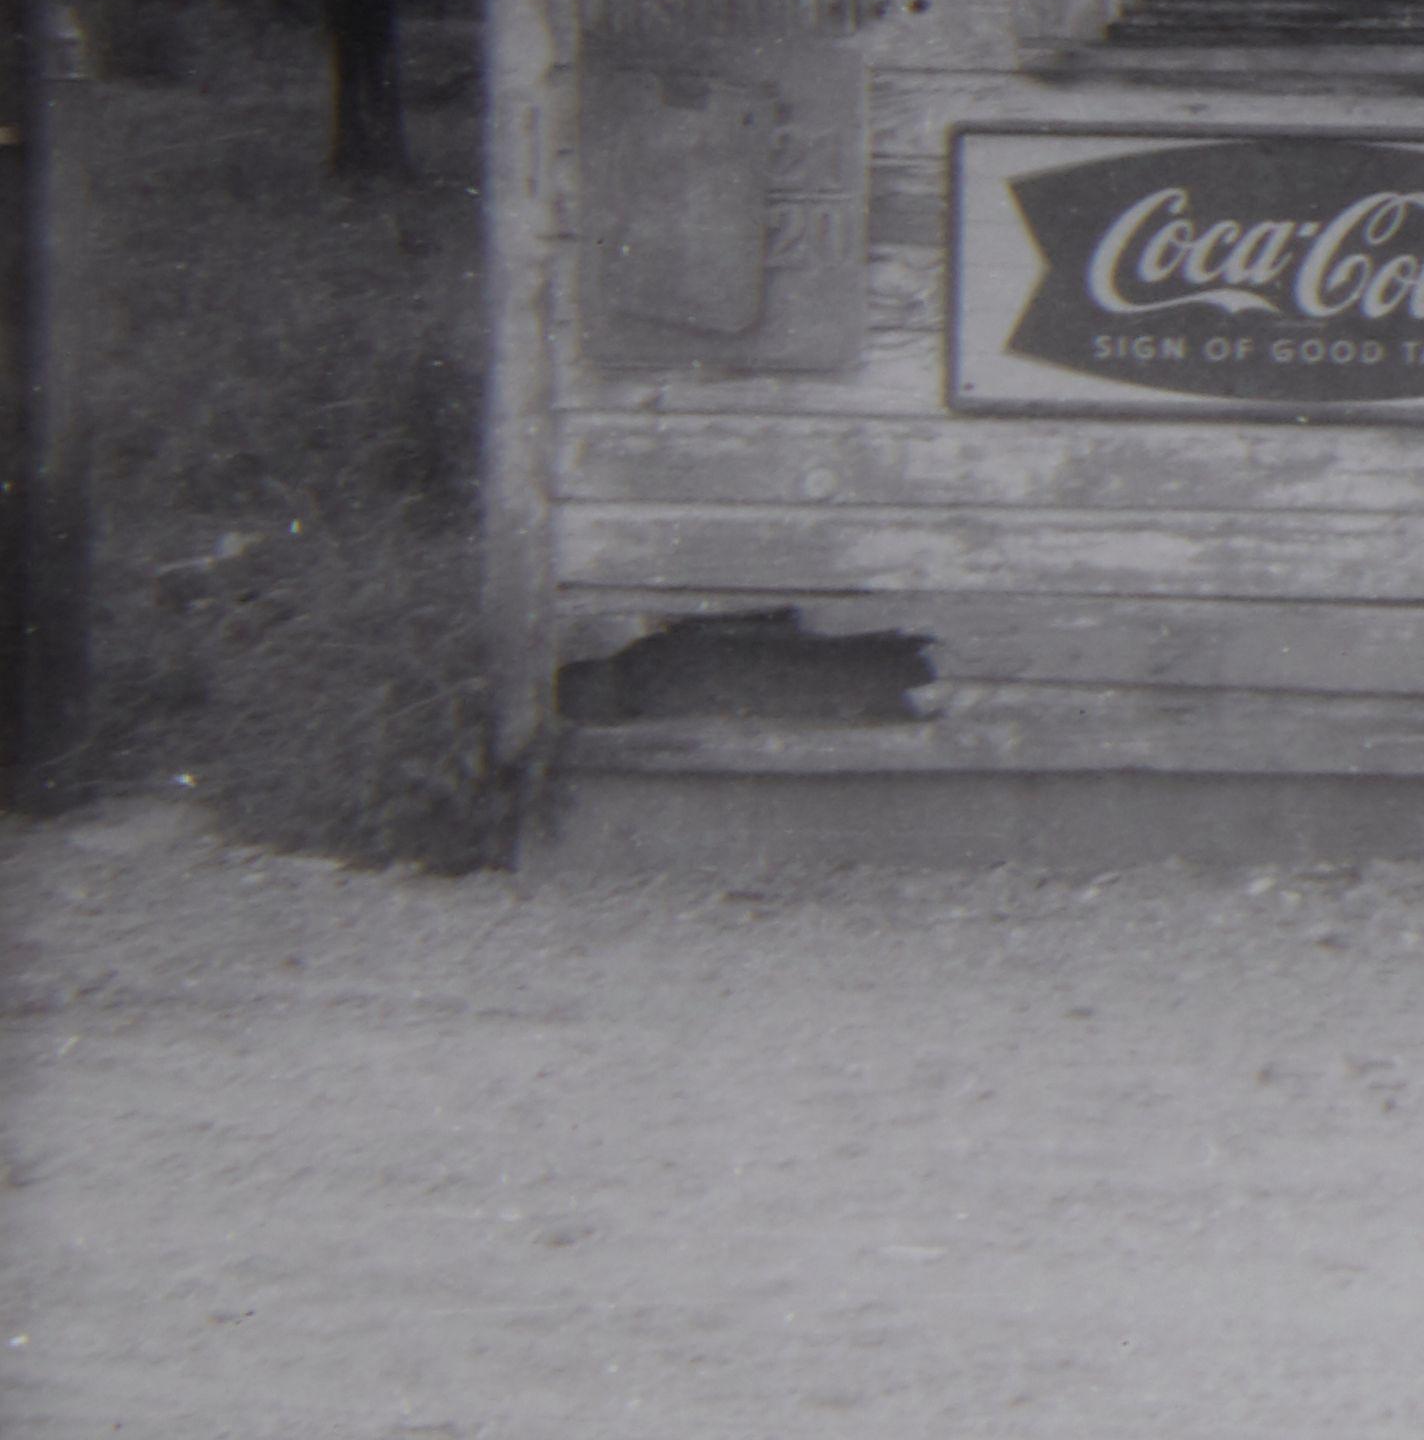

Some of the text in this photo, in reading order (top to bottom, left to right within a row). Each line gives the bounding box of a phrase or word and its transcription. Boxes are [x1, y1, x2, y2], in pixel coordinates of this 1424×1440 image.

[1094, 334, 1188, 361] SIGN
[1206, 336, 1256, 362] OF
[1272, 337, 1384, 364] GOOD
